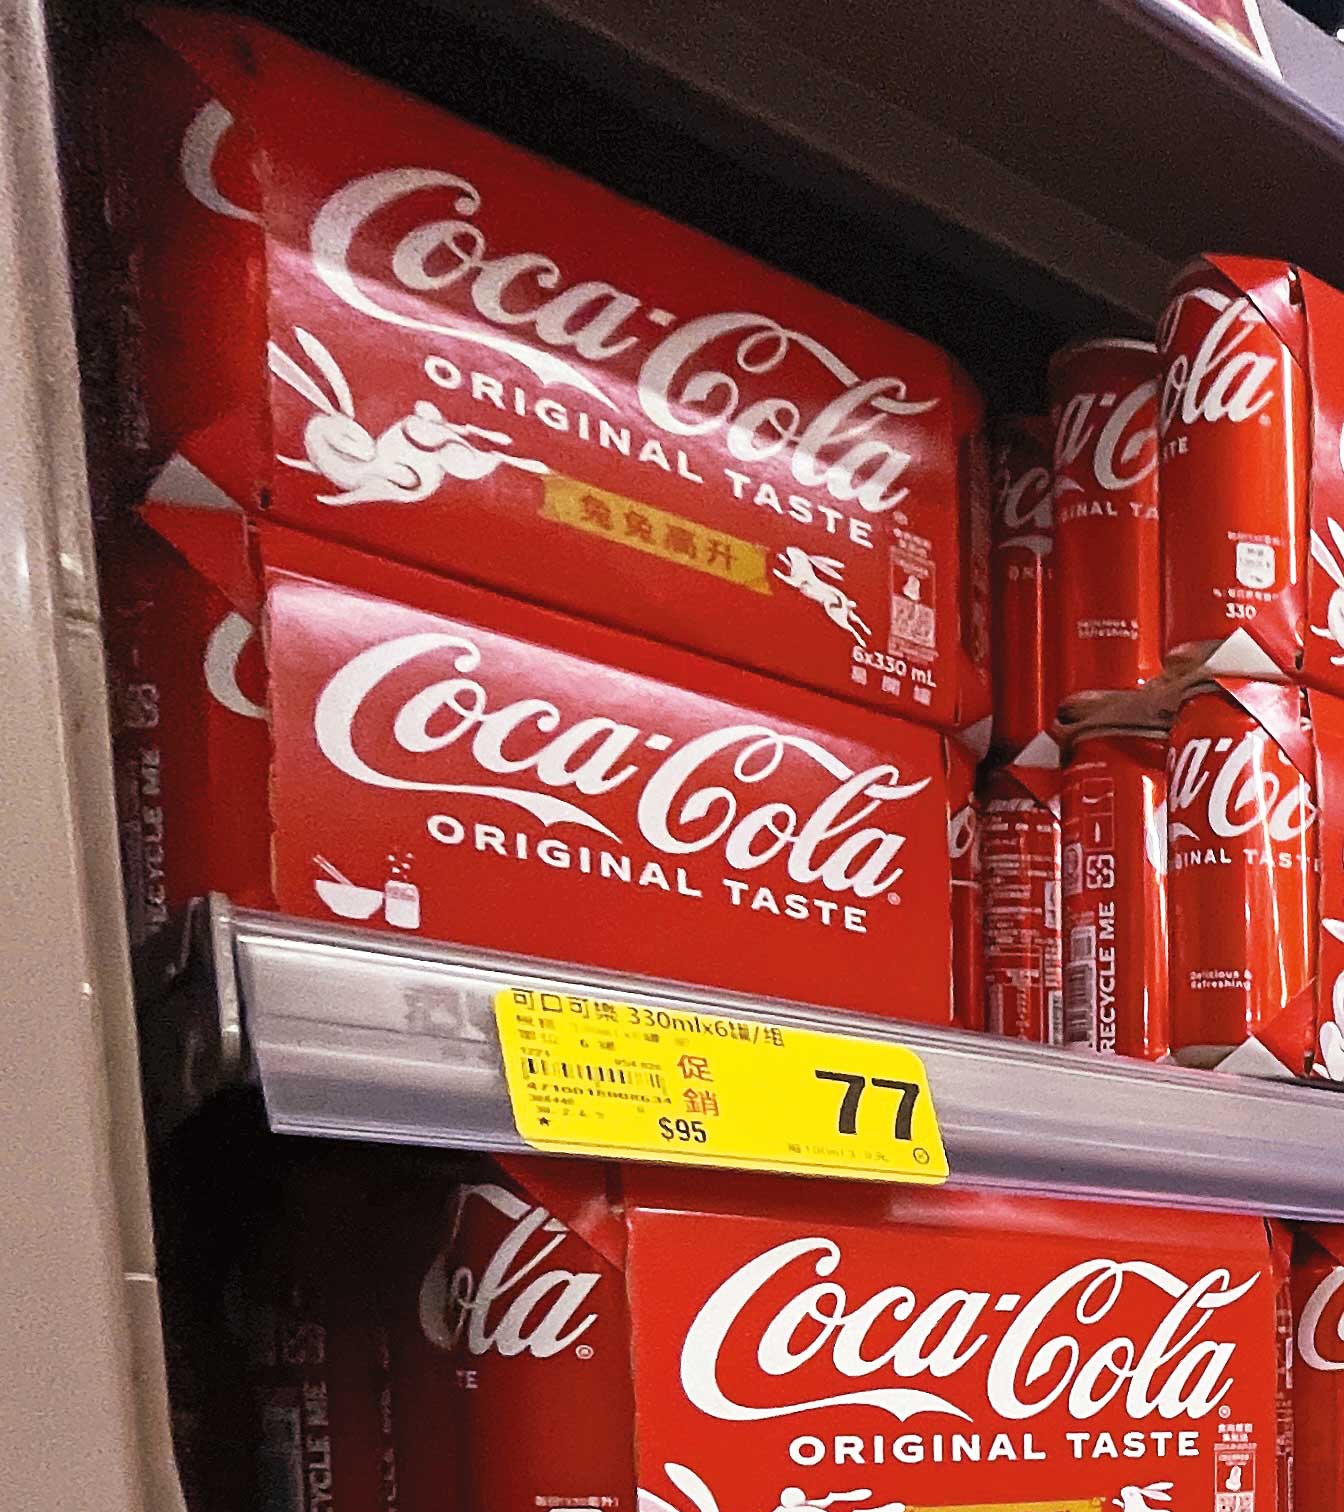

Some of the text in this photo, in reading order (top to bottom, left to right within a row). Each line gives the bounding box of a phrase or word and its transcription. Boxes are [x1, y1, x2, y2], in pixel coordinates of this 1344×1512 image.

[310, 168, 940, 513] Coca-Cola
[424, 355, 876, 550] ORIGINAL TASTE
[314, 632, 932, 901] Coca-Cola
[428, 815, 869, 934] ORIGINAL TASTE
[512, 987, 619, 1024] 可口可樂
[1098, 901, 1117, 1051] RECYCLE ME
[658, 1115, 708, 1143] $95
[815, 1068, 920, 1141] 77
[680, 1236, 1261, 1422] Coca-Cola
[788, 1434, 1046, 1466] ORIGINAL
[1066, 1431, 1201, 1459] TASTE
